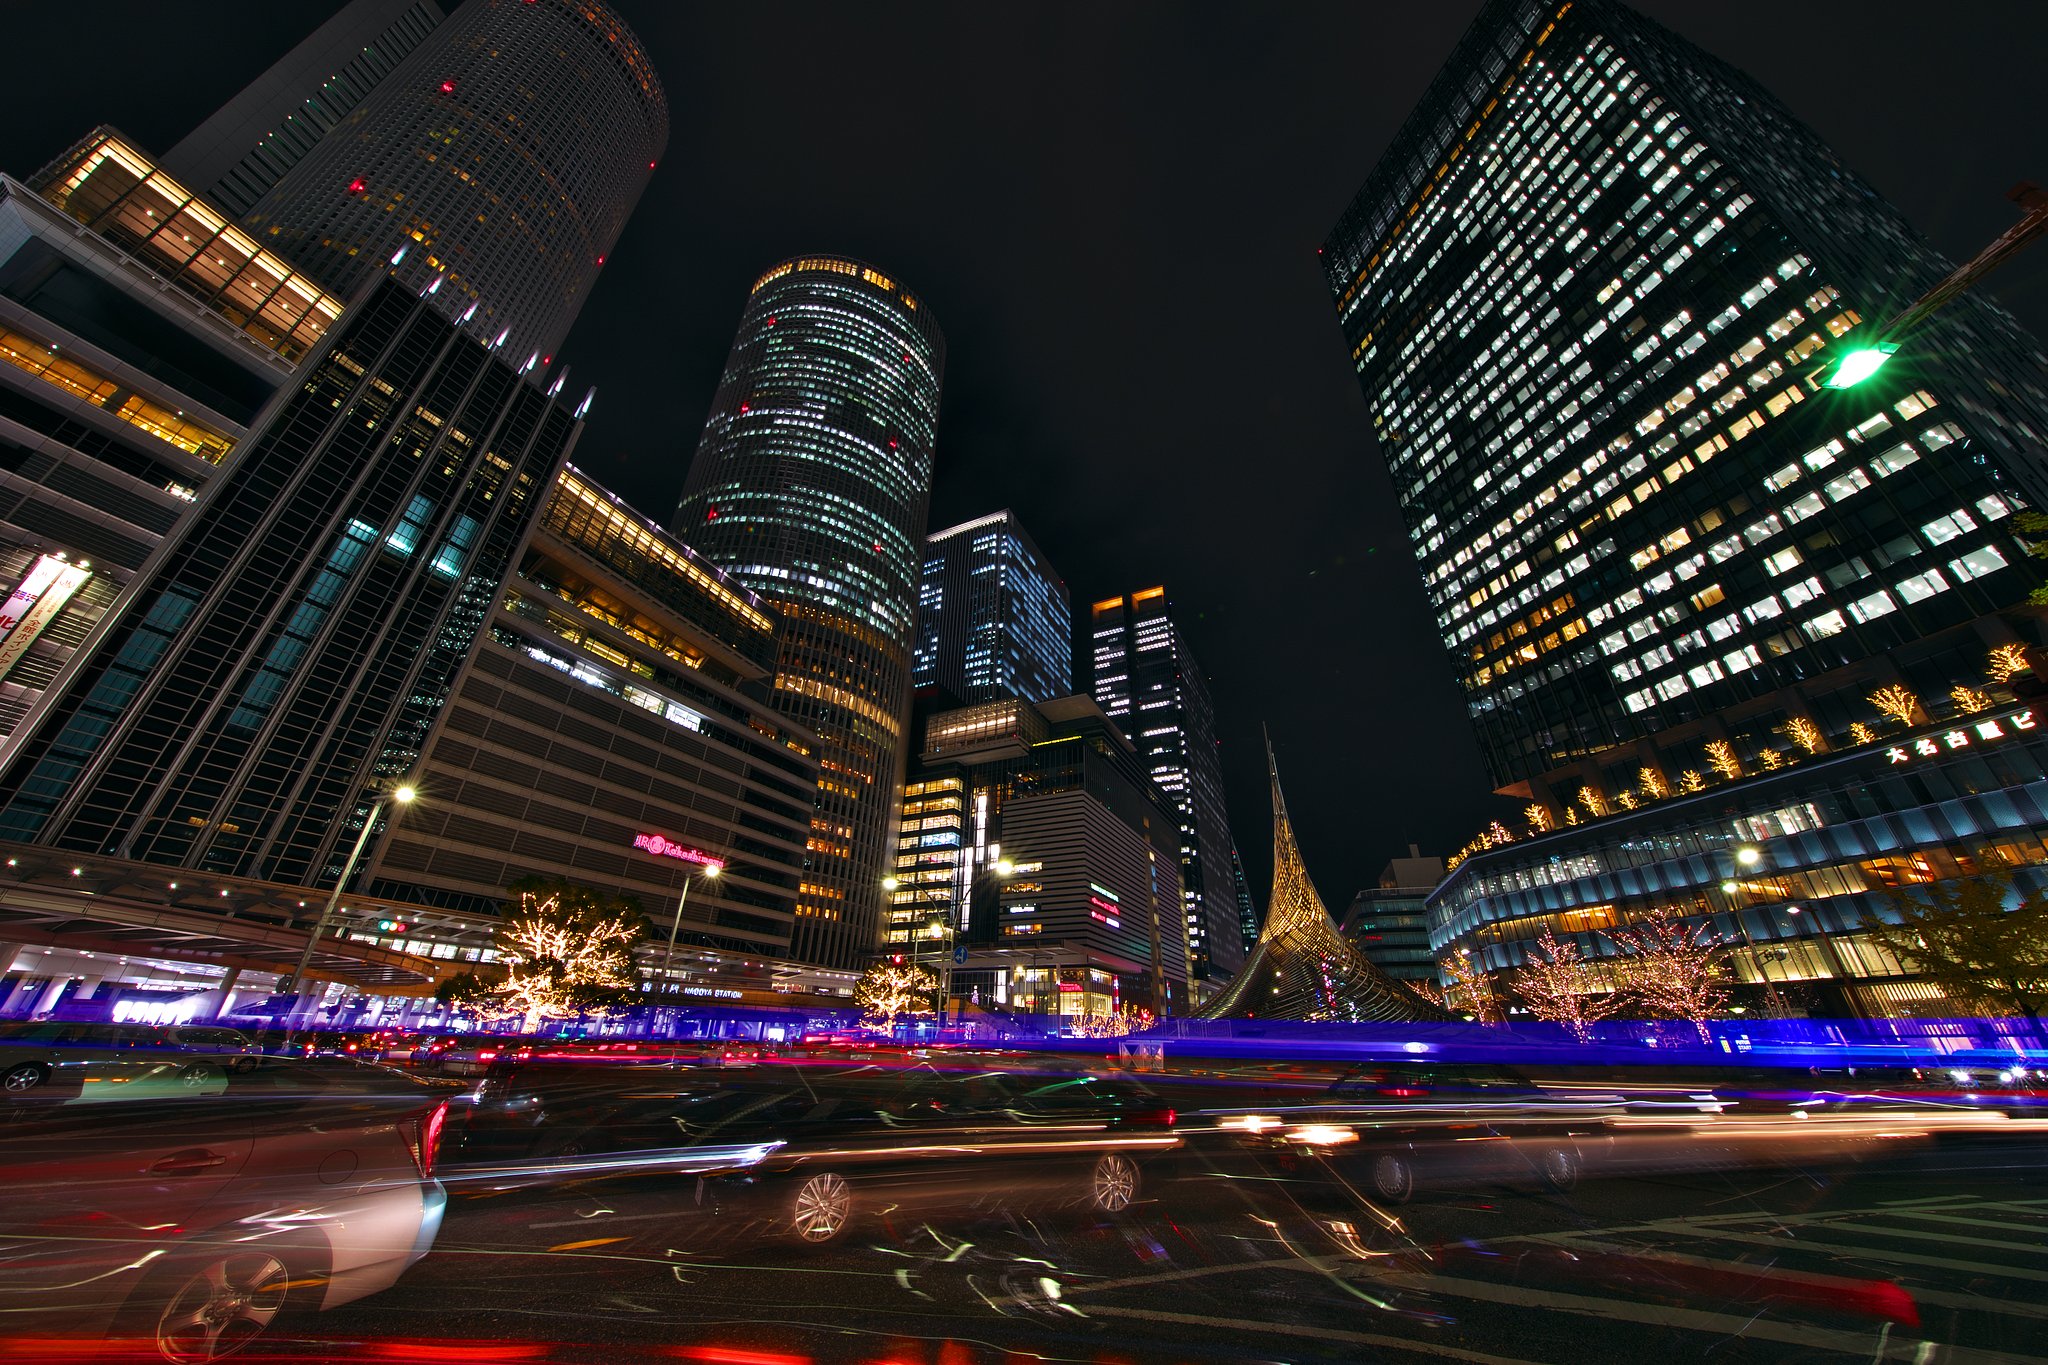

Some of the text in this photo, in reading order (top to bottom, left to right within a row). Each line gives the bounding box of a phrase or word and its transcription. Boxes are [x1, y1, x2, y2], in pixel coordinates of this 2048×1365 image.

[633, 835, 724, 869] JR Takashimaya
[684, 986, 713, 996] NAGOYA
[714, 989, 743, 999] STATION
